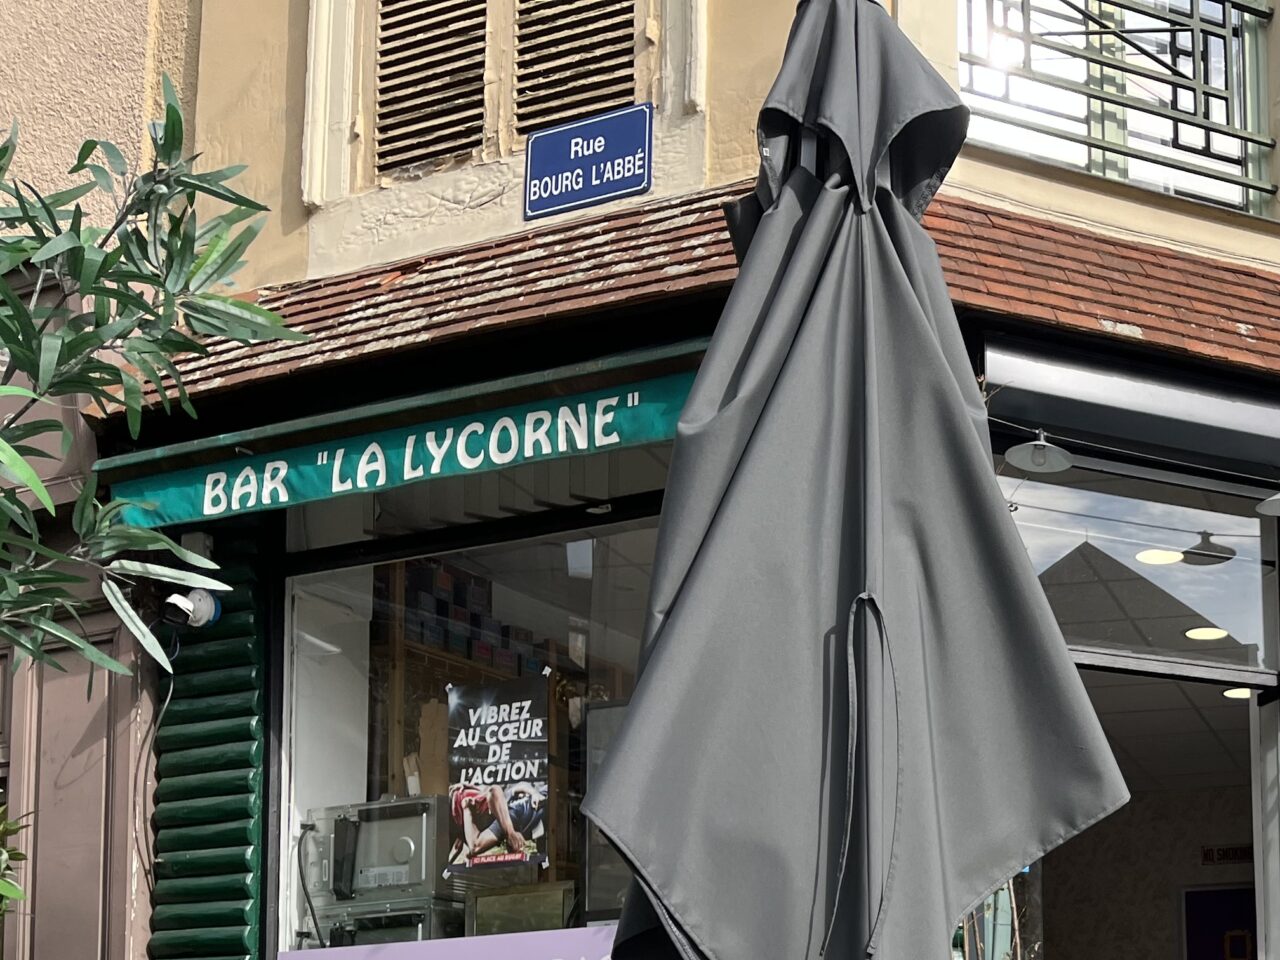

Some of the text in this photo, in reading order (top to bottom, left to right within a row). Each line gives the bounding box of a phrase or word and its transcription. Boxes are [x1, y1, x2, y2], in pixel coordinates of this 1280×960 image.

[570, 136, 605, 159] Rue
[530, 148, 645, 201] BOURG L'ABBÉ
[203, 460, 289, 516] BAR
[468, 700, 532, 726] VIBREZ
[453, 718, 543, 748] AU CŒUR
[487, 742, 512, 763] DE
[460, 759, 540, 785] L'ACTION
